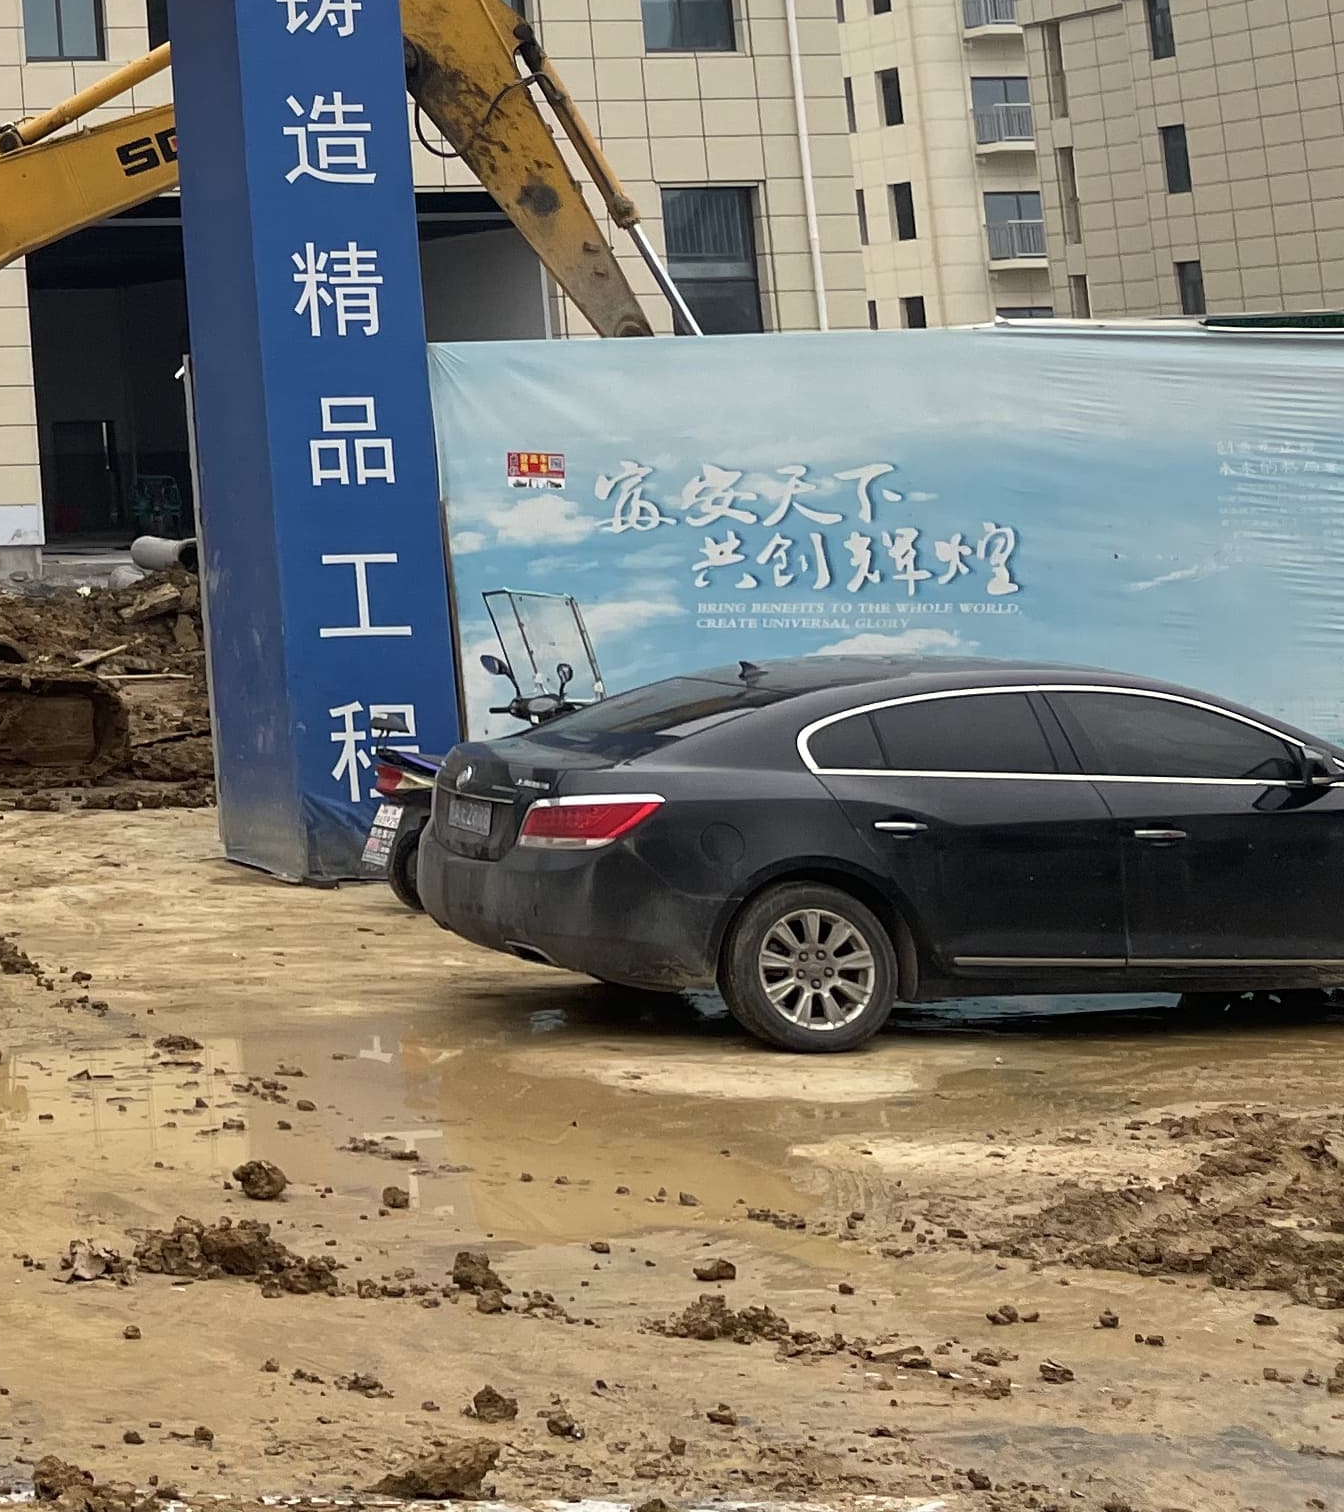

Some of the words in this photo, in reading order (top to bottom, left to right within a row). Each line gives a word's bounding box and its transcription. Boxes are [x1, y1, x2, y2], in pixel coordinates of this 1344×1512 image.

[595, 461, 903, 534] 富安天下
[691, 522, 1019, 596] 共创辉煌
[696, 618, 757, 629] CREATE
[763, 618, 850, 629] UNIVERSAL
[855, 618, 911, 629] GLORY
[698, 602, 746, 614] BRING
[752, 602, 824, 614] BENEFITS
[832, 602, 852, 614] TO
[858, 602, 890, 614] THE
[896, 602, 953, 614] WHOLE
[960, 602, 1023, 616] WORLD,
